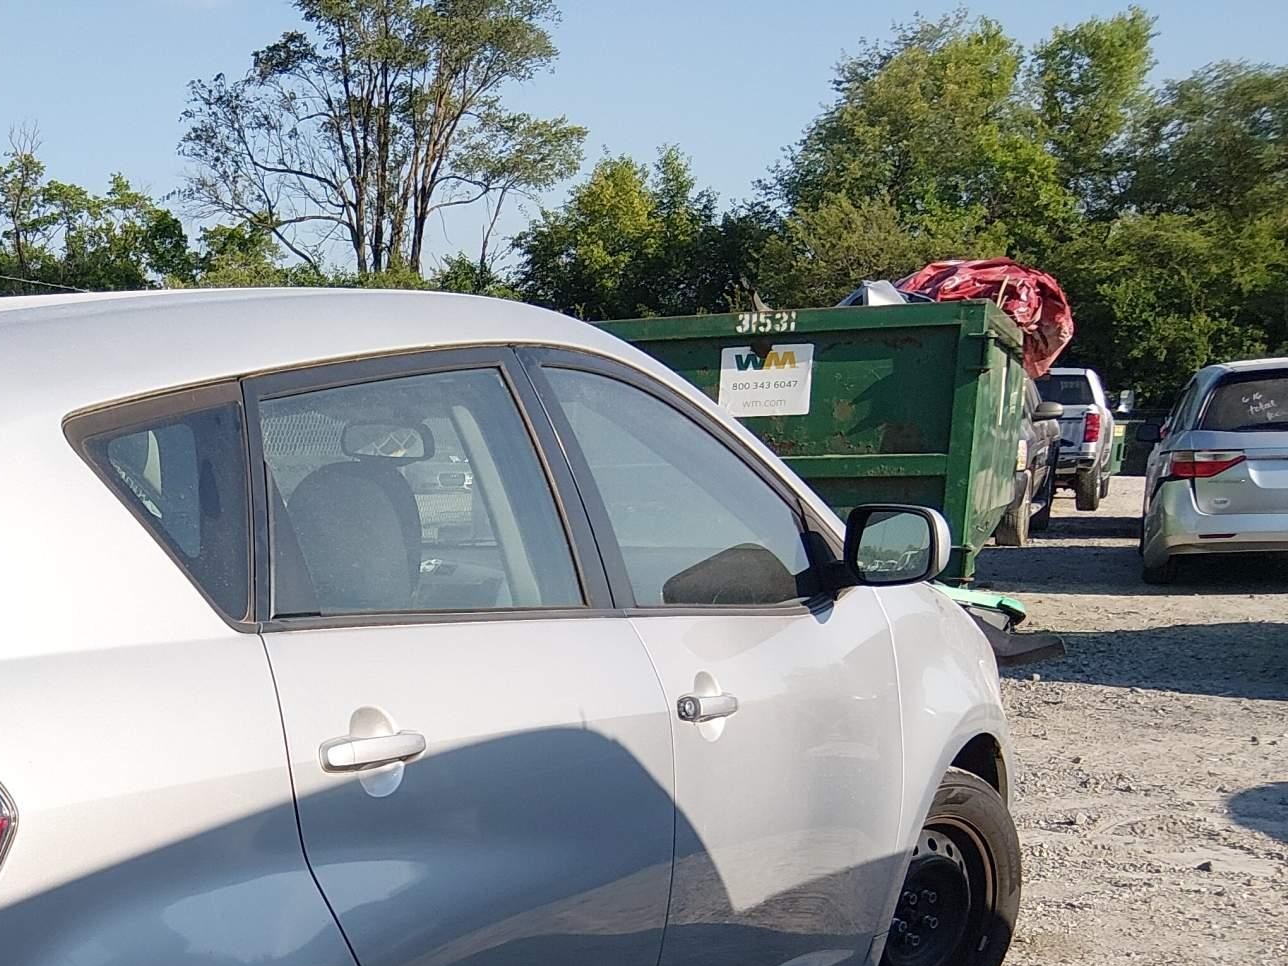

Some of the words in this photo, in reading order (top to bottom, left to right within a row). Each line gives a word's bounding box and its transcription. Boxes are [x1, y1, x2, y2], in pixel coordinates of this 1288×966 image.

[736, 311, 796, 333] 31531
[735, 351, 797, 370] WM
[732, 382, 750, 391] 800
[753, 382, 771, 390] 343
[774, 380, 799, 389] 6047
[742, 399, 786, 408] wm.com
